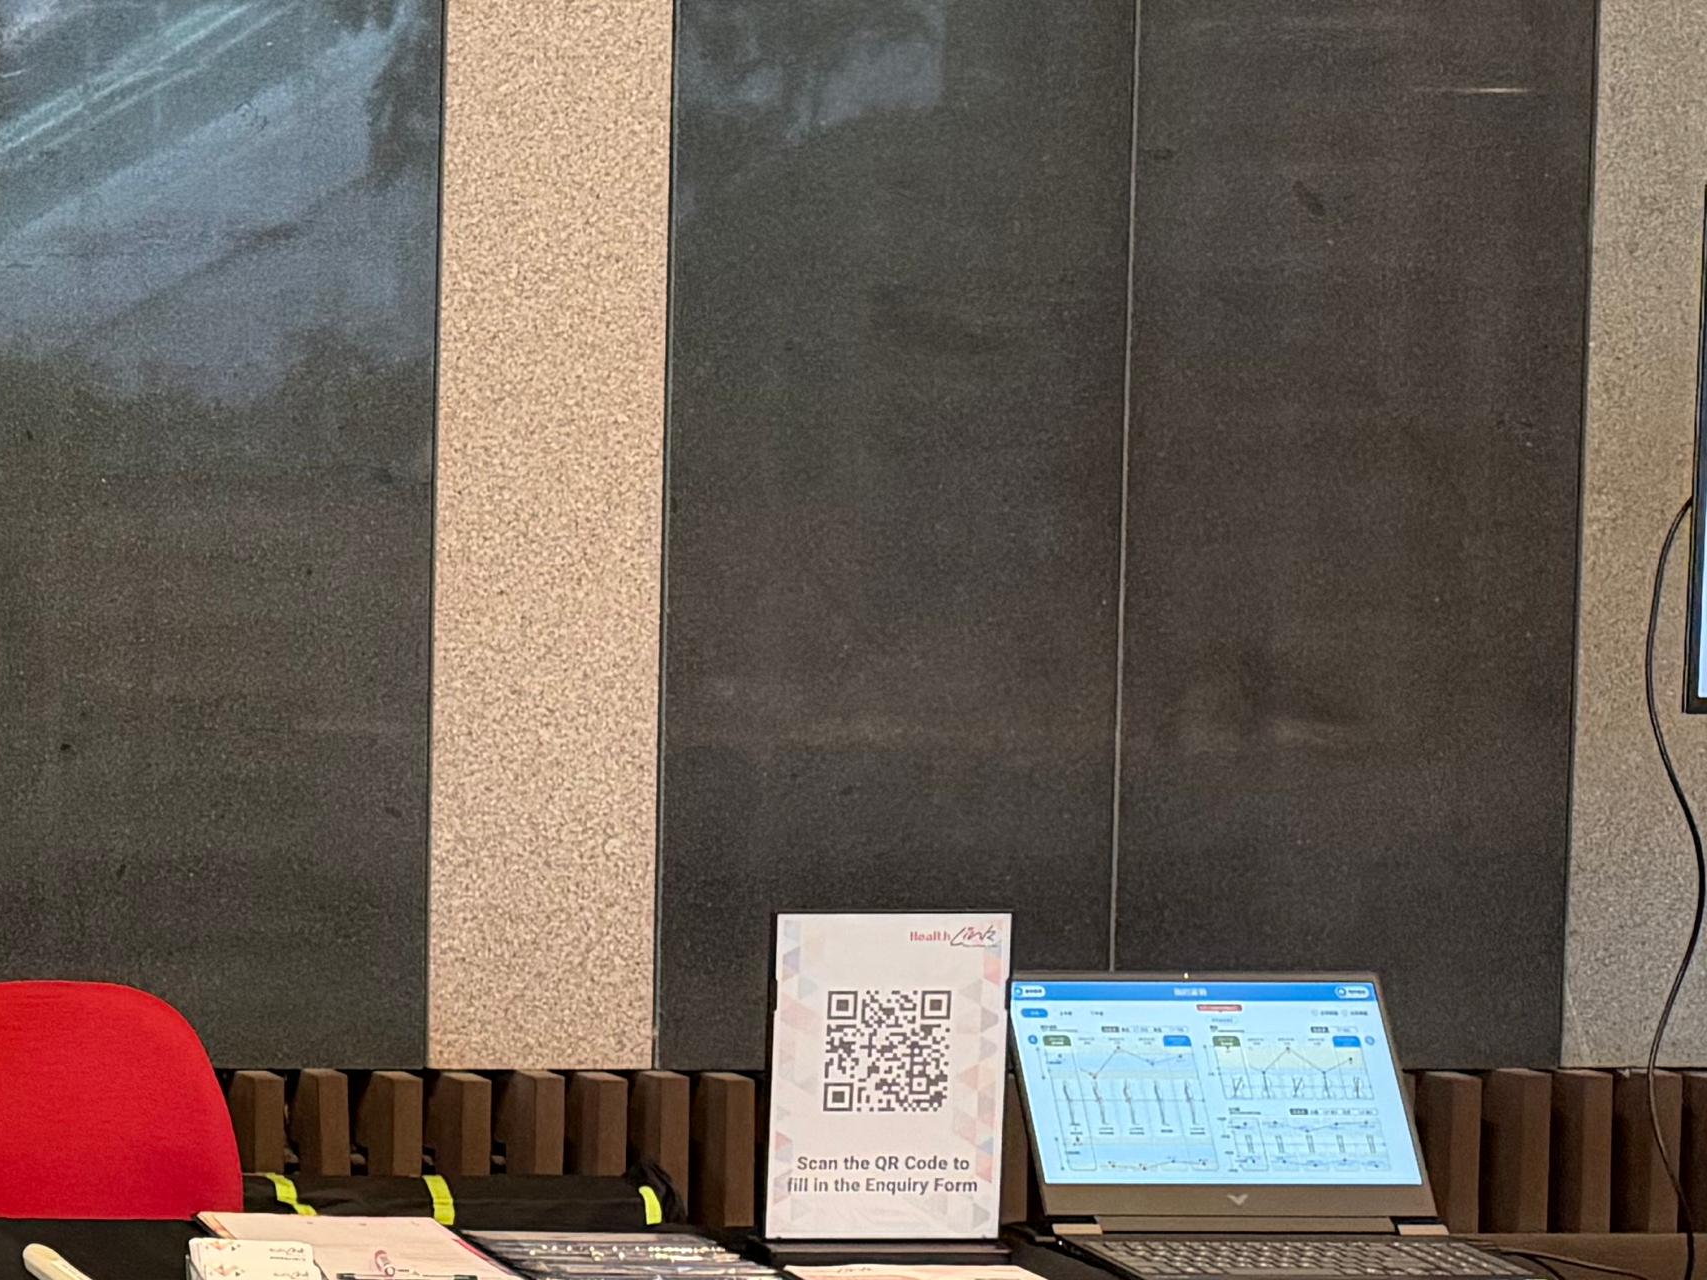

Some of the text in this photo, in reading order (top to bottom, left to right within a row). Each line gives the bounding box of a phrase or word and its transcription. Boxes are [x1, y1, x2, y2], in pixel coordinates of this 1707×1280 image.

[910, 924, 996, 946] Health Link
[797, 1156, 970, 1172] Scan the QR Code to
[787, 1178, 978, 1196] fill in the Enquiry Form
